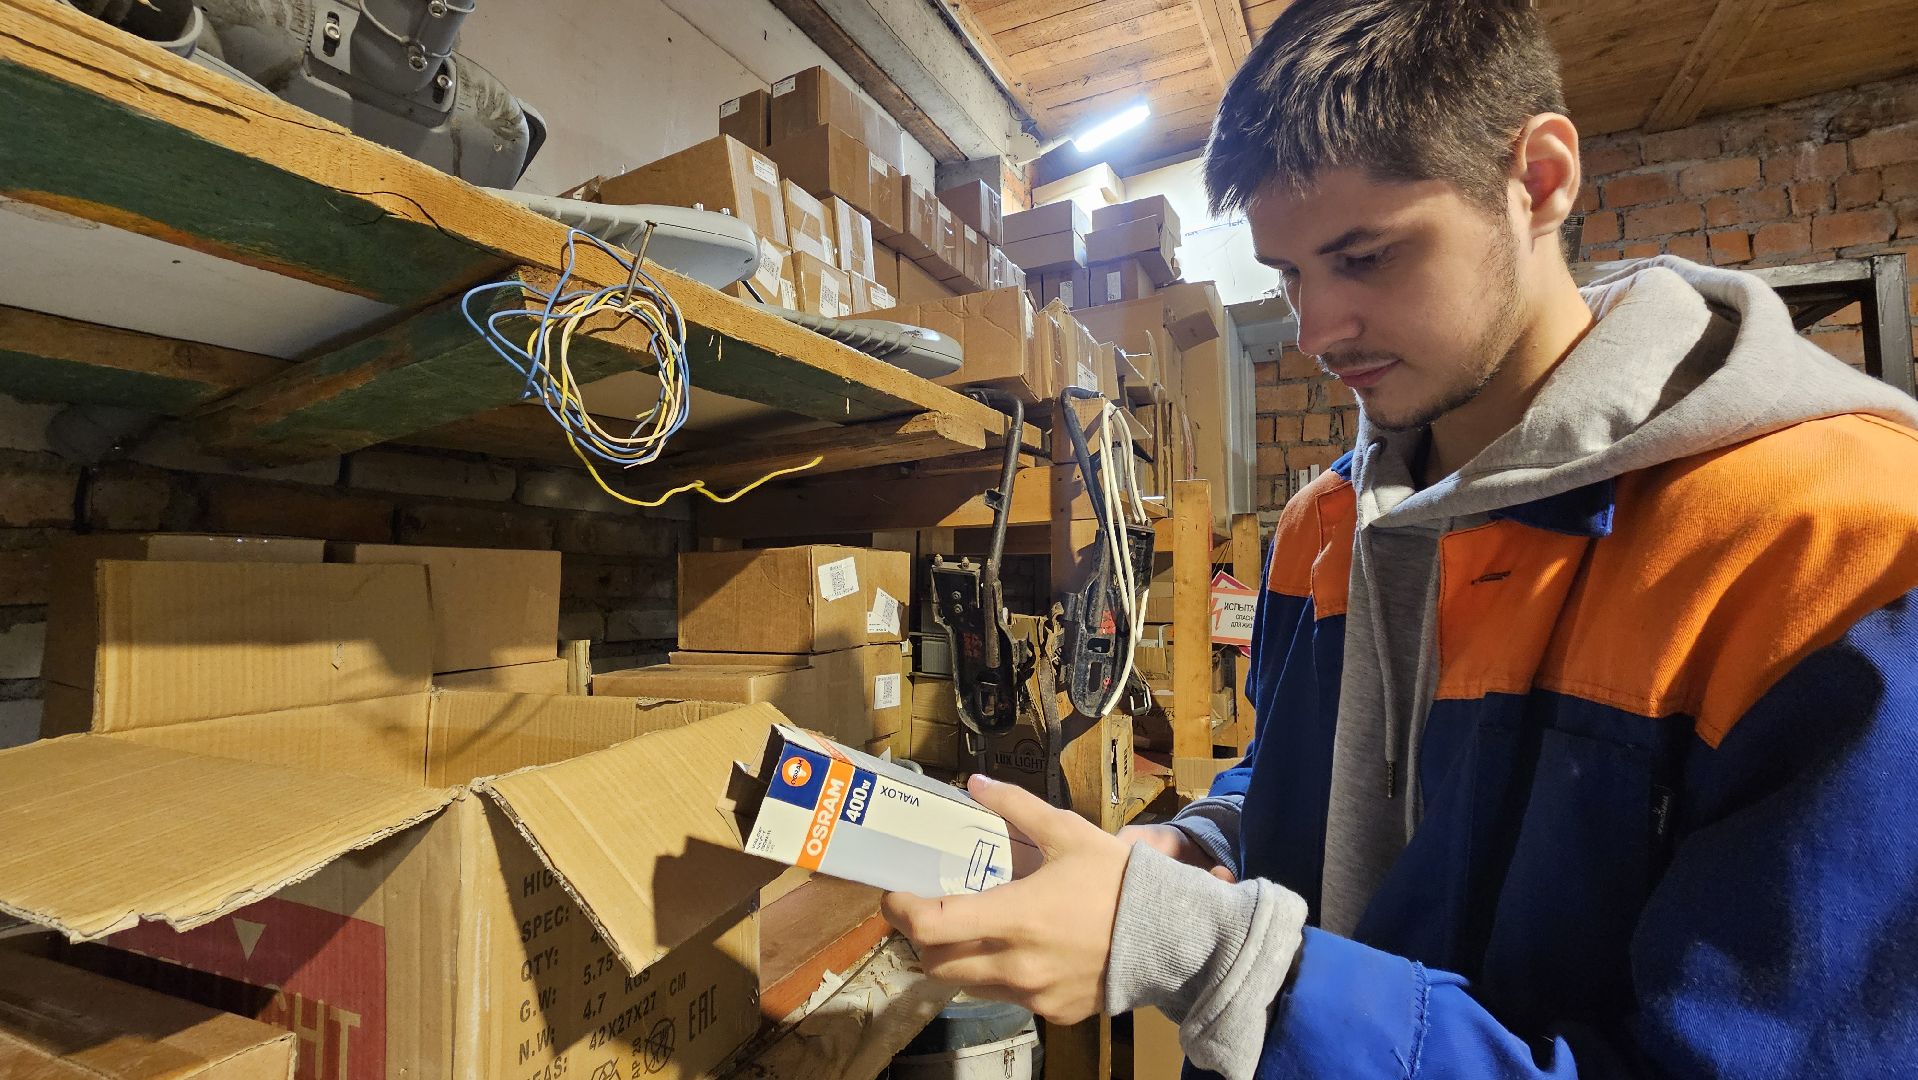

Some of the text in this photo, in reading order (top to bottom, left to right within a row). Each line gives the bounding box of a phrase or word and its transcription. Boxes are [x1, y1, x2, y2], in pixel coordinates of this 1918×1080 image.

[1224, 602, 1255, 612] ИСПЫТА
[790, 759, 803, 785] OSRAM
[995, 753, 1046, 770] LUX LIGHT
[880, 785, 920, 807] VIALOX
[806, 778, 846, 857] OSRAM
[523, 868, 558, 898] HIG
[521, 904, 569, 943] SPEC:
[520, 946, 559, 983] QTY:
[519, 952, 614, 1023] G.W: 5.75
[589, 991, 657, 1051] 42X27X27
[669, 971, 687, 997] CM
[518, 1025, 556, 1066] N.W:
[582, 992, 607, 1020] 4.7
[631, 1060, 641, 1080] AP
